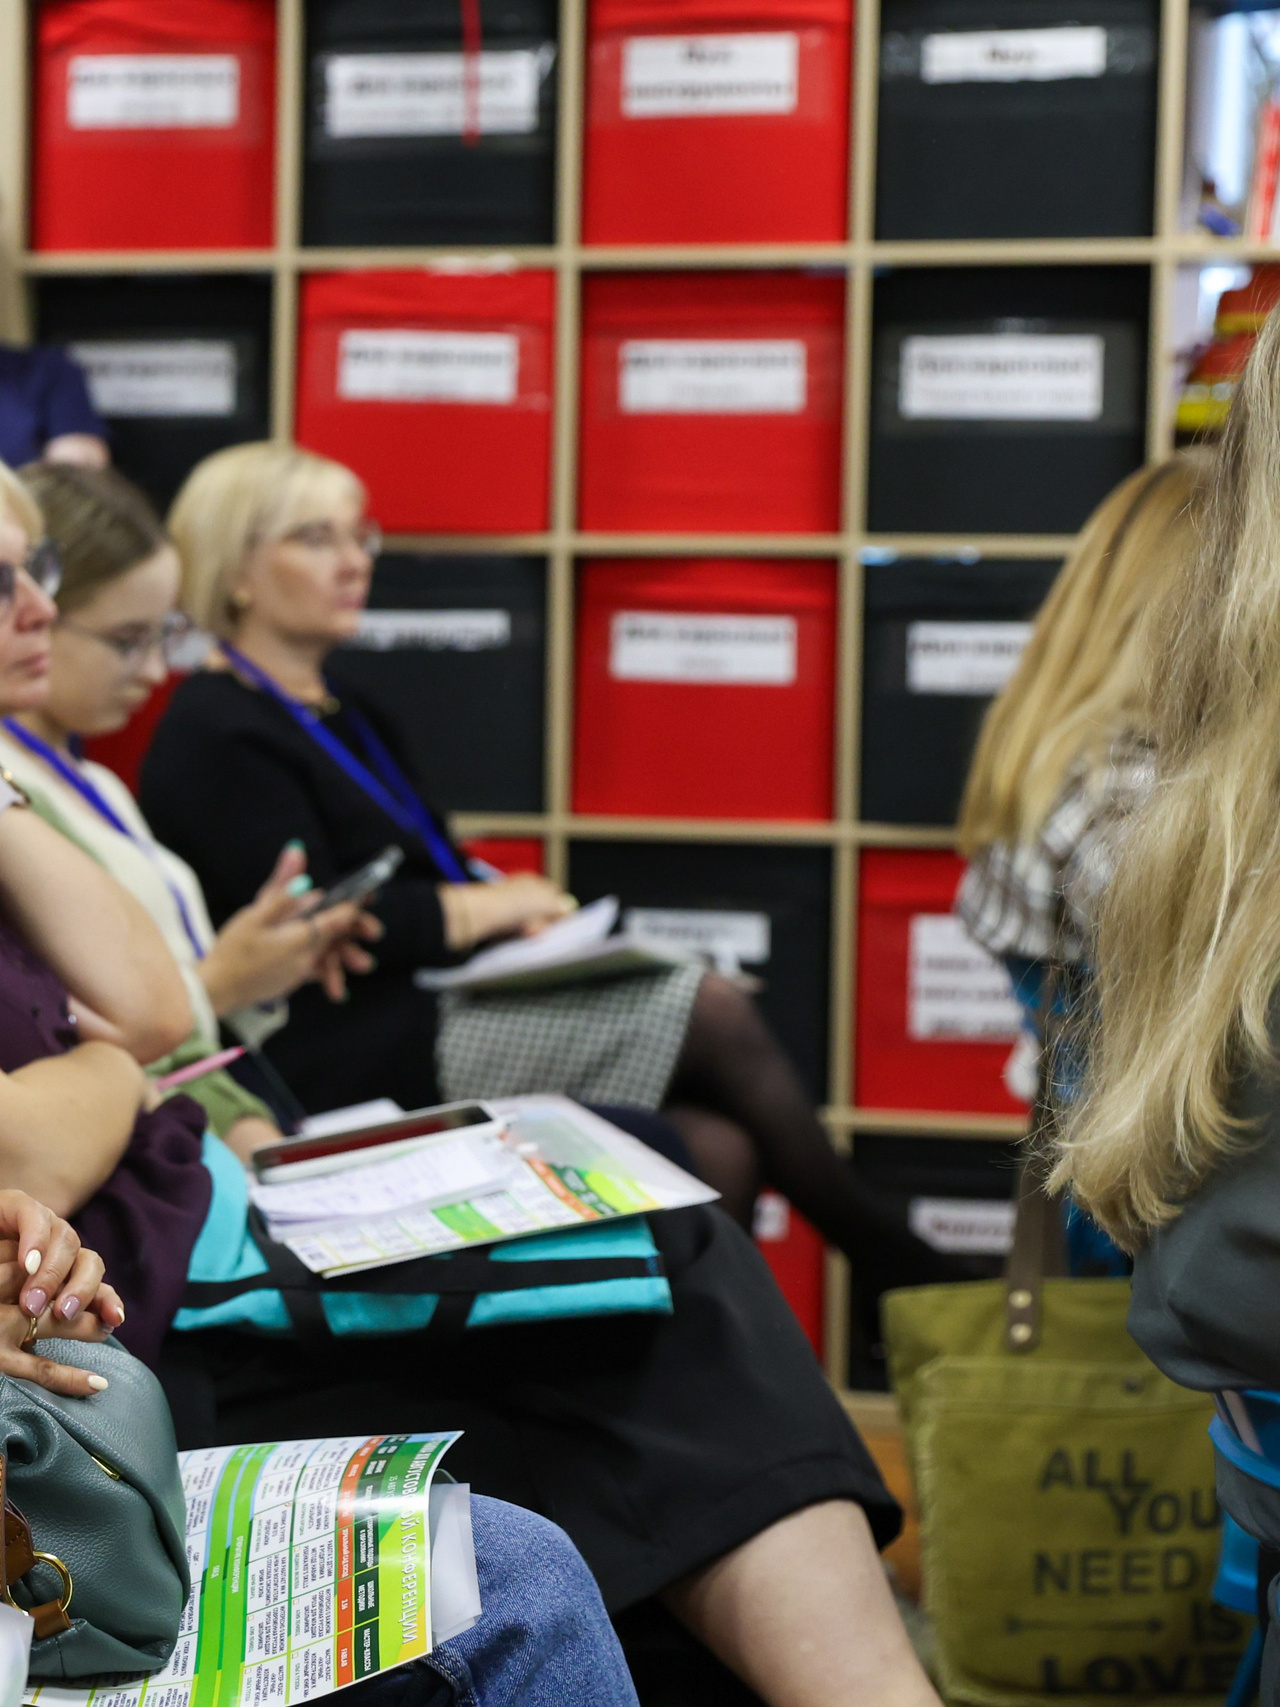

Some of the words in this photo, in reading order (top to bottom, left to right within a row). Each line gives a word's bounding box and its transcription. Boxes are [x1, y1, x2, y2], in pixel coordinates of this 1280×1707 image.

[1038, 1448, 1152, 1492] ALL
[400, 1460, 427, 1531] АВГУСТОВОЙ
[1106, 1486, 1223, 1537] YOU
[235, 1536, 244, 1558] ОТКРЫТИЕ
[210, 1565, 220, 1578] ОБЕД
[230, 1558, 242, 1593] КОНФЕРЕНЦИИ
[398, 1533, 418, 1644] КОНФЕРЕНЦИИ
[1032, 1549, 1201, 1598] NEED
[357, 1584, 365, 1612] МЕТОДИКИ
[1188, 1601, 1245, 1645] IS
[172, 1650, 181, 1676] ЗАПОМИНАТЬ
[180, 1655, 189, 1676] ПОНИМАТЬ
[340, 1648, 348, 1668] FABLAB
[363, 1628, 371, 1671] МАСТЕР-КЛАССЫ
[1038, 1654, 1242, 1697] LOVE
